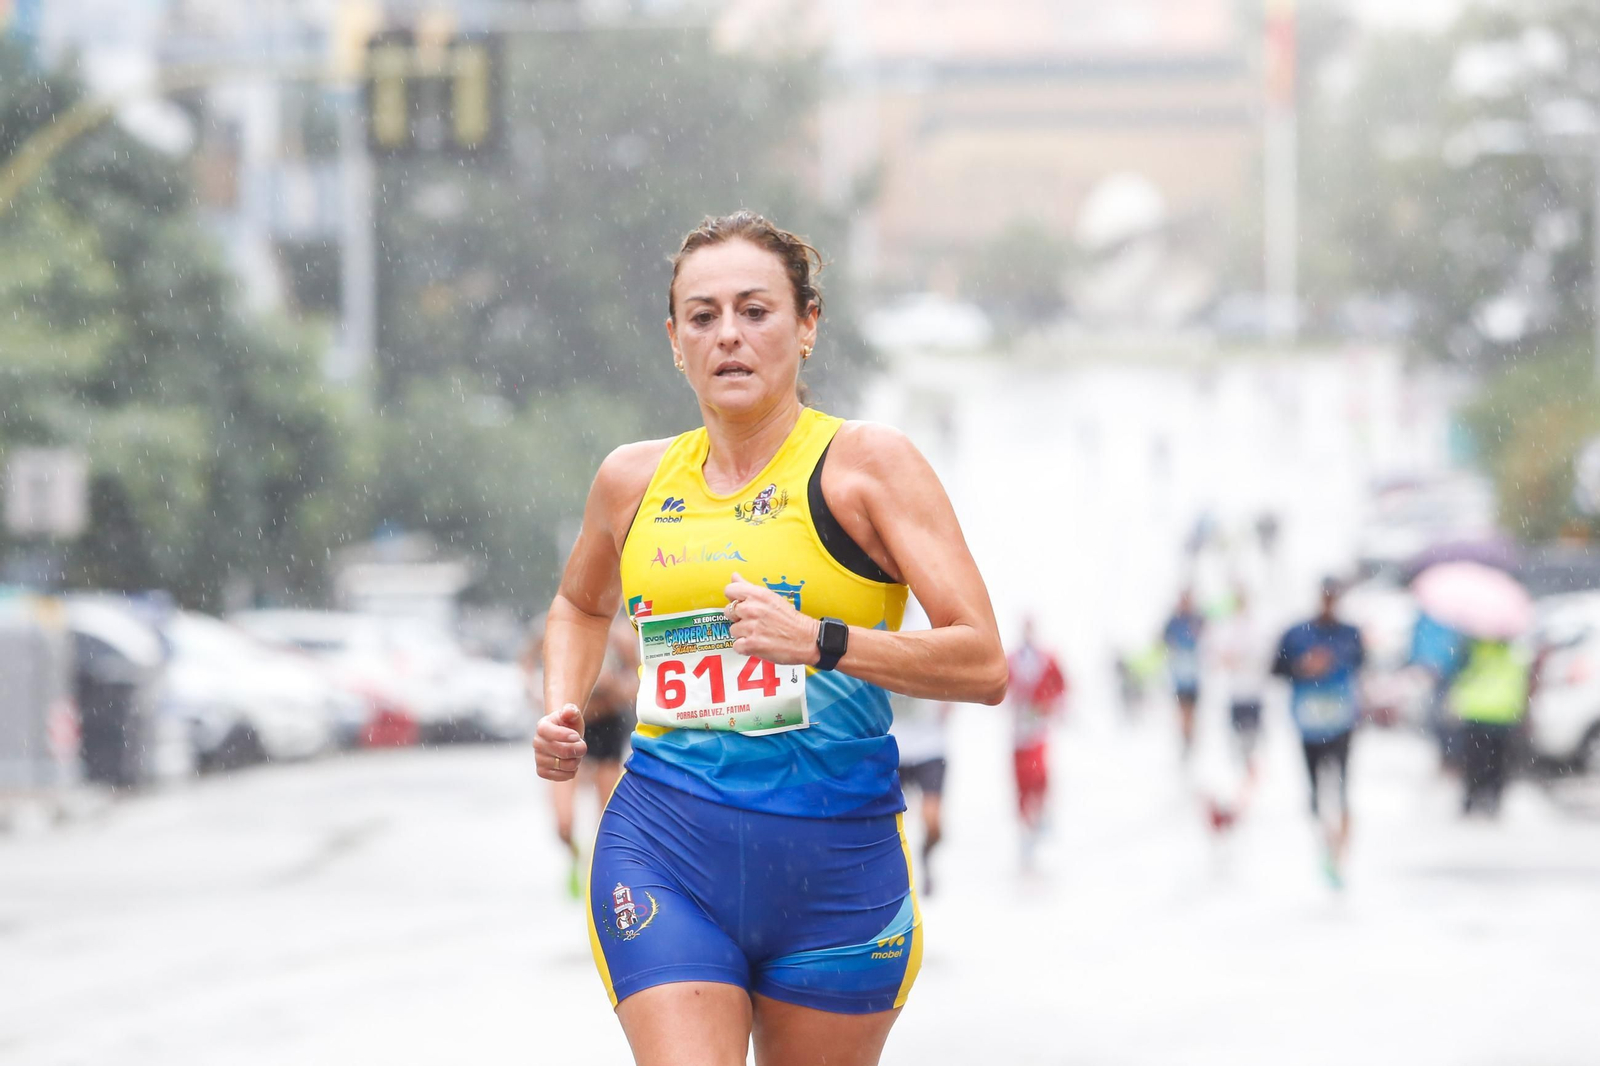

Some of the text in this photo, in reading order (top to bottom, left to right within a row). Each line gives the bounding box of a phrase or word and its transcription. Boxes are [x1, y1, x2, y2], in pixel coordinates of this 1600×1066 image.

[650, 541, 748, 568] Andalucía
[665, 625, 709, 647] CARRERA
[655, 654, 781, 710] 614
[676, 704, 751, 720] PORRAS GALVEZ, FATIMA
[871, 948, 903, 959] mobel
